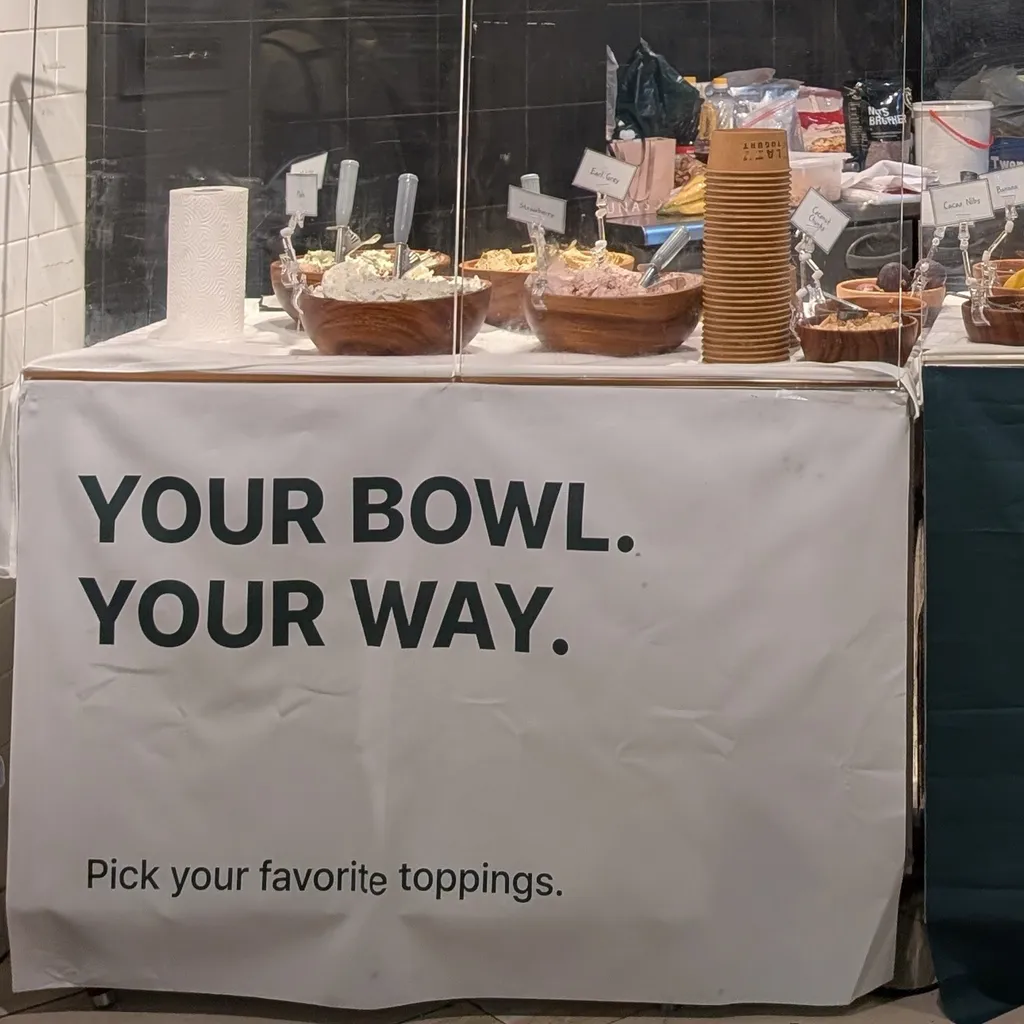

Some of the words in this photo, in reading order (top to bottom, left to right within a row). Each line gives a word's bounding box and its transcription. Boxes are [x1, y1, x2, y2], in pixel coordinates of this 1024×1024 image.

[590, 167, 604, 178] Earl
[606, 172, 621, 185] Grey
[78, 474, 325, 546] YOUR
[352, 475, 636, 554] BOWL.
[78, 576, 326, 649] YOUR
[350, 578, 570, 656] WAY.
[86, 858, 160, 892] Pick
[170, 862, 250, 900] your
[259, 859, 388, 898] favorite
[398, 862, 565, 905] toppings.
